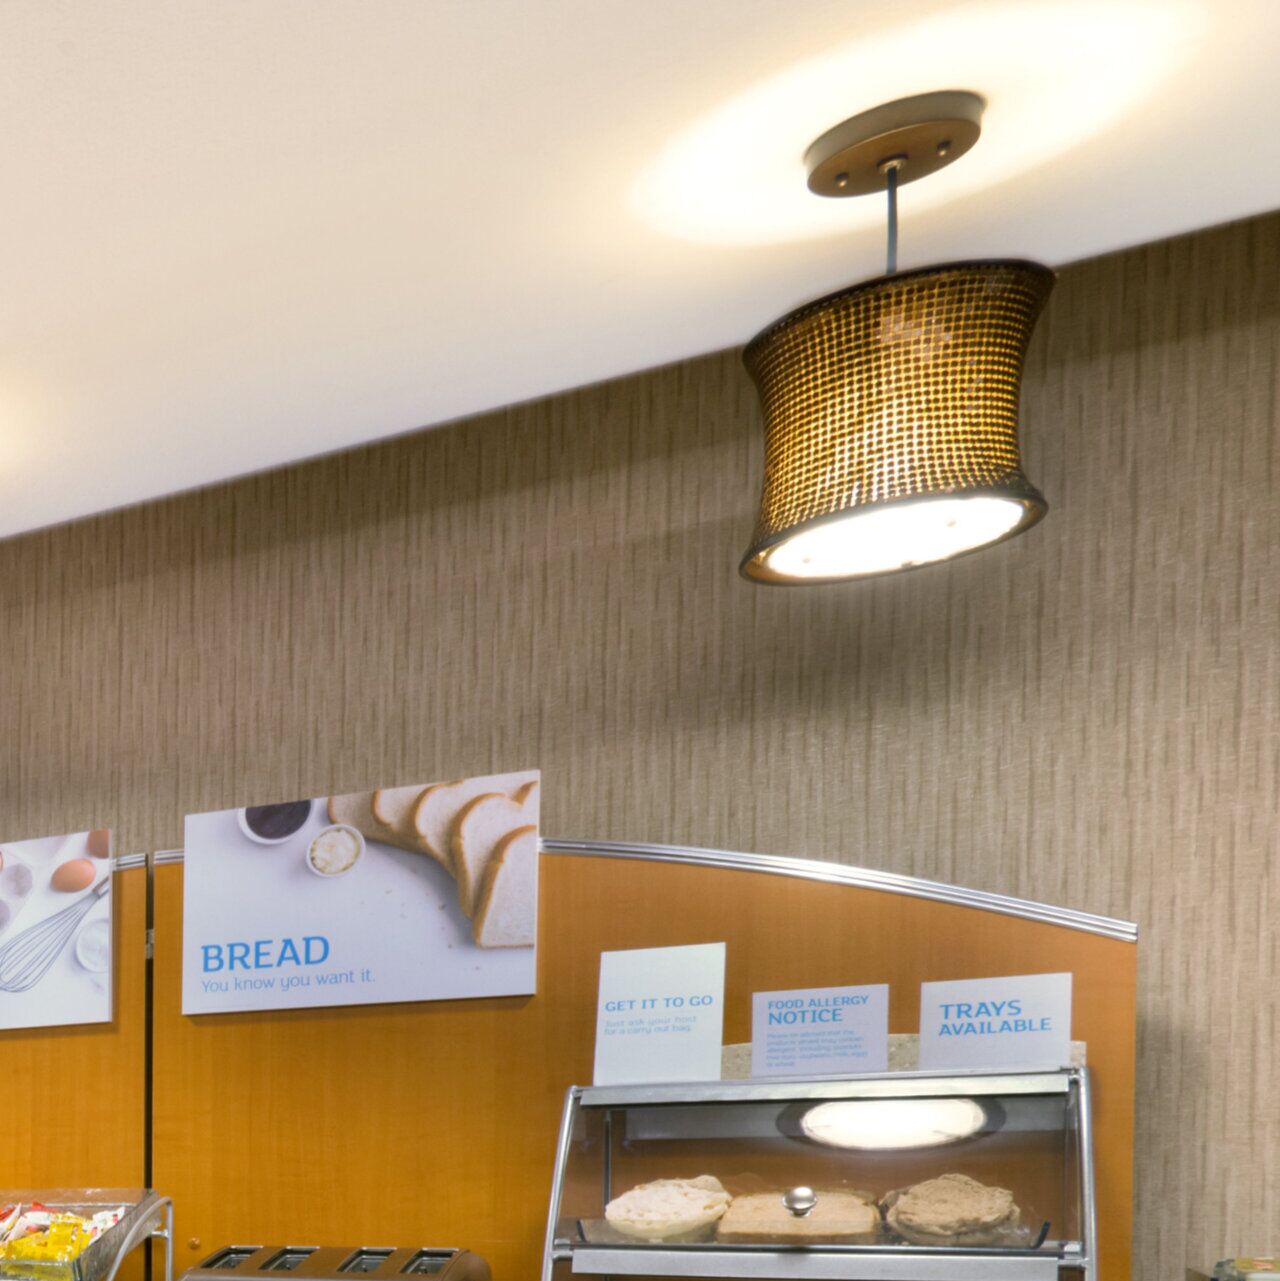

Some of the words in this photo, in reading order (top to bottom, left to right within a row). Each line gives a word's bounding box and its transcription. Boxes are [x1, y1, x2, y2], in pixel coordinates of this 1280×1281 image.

[201, 935, 330, 972] BREAD
[201, 979, 228, 993] You
[234, 977, 275, 991] know
[280, 976, 311, 991] you
[316, 970, 355, 984] want
[361, 968, 376, 983] it.
[605, 1000, 636, 1012] GET
[641, 998, 658, 1009] IT
[663, 996, 684, 1008] TO
[689, 995, 713, 1006] GO
[768, 999, 804, 1010] FOOD
[807, 995, 869, 1008] ALLERGY
[939, 1000, 1022, 1019] TRAYS
[768, 1008, 844, 1025] NOTICE
[938, 1017, 1052, 1036] AVAILABLE
